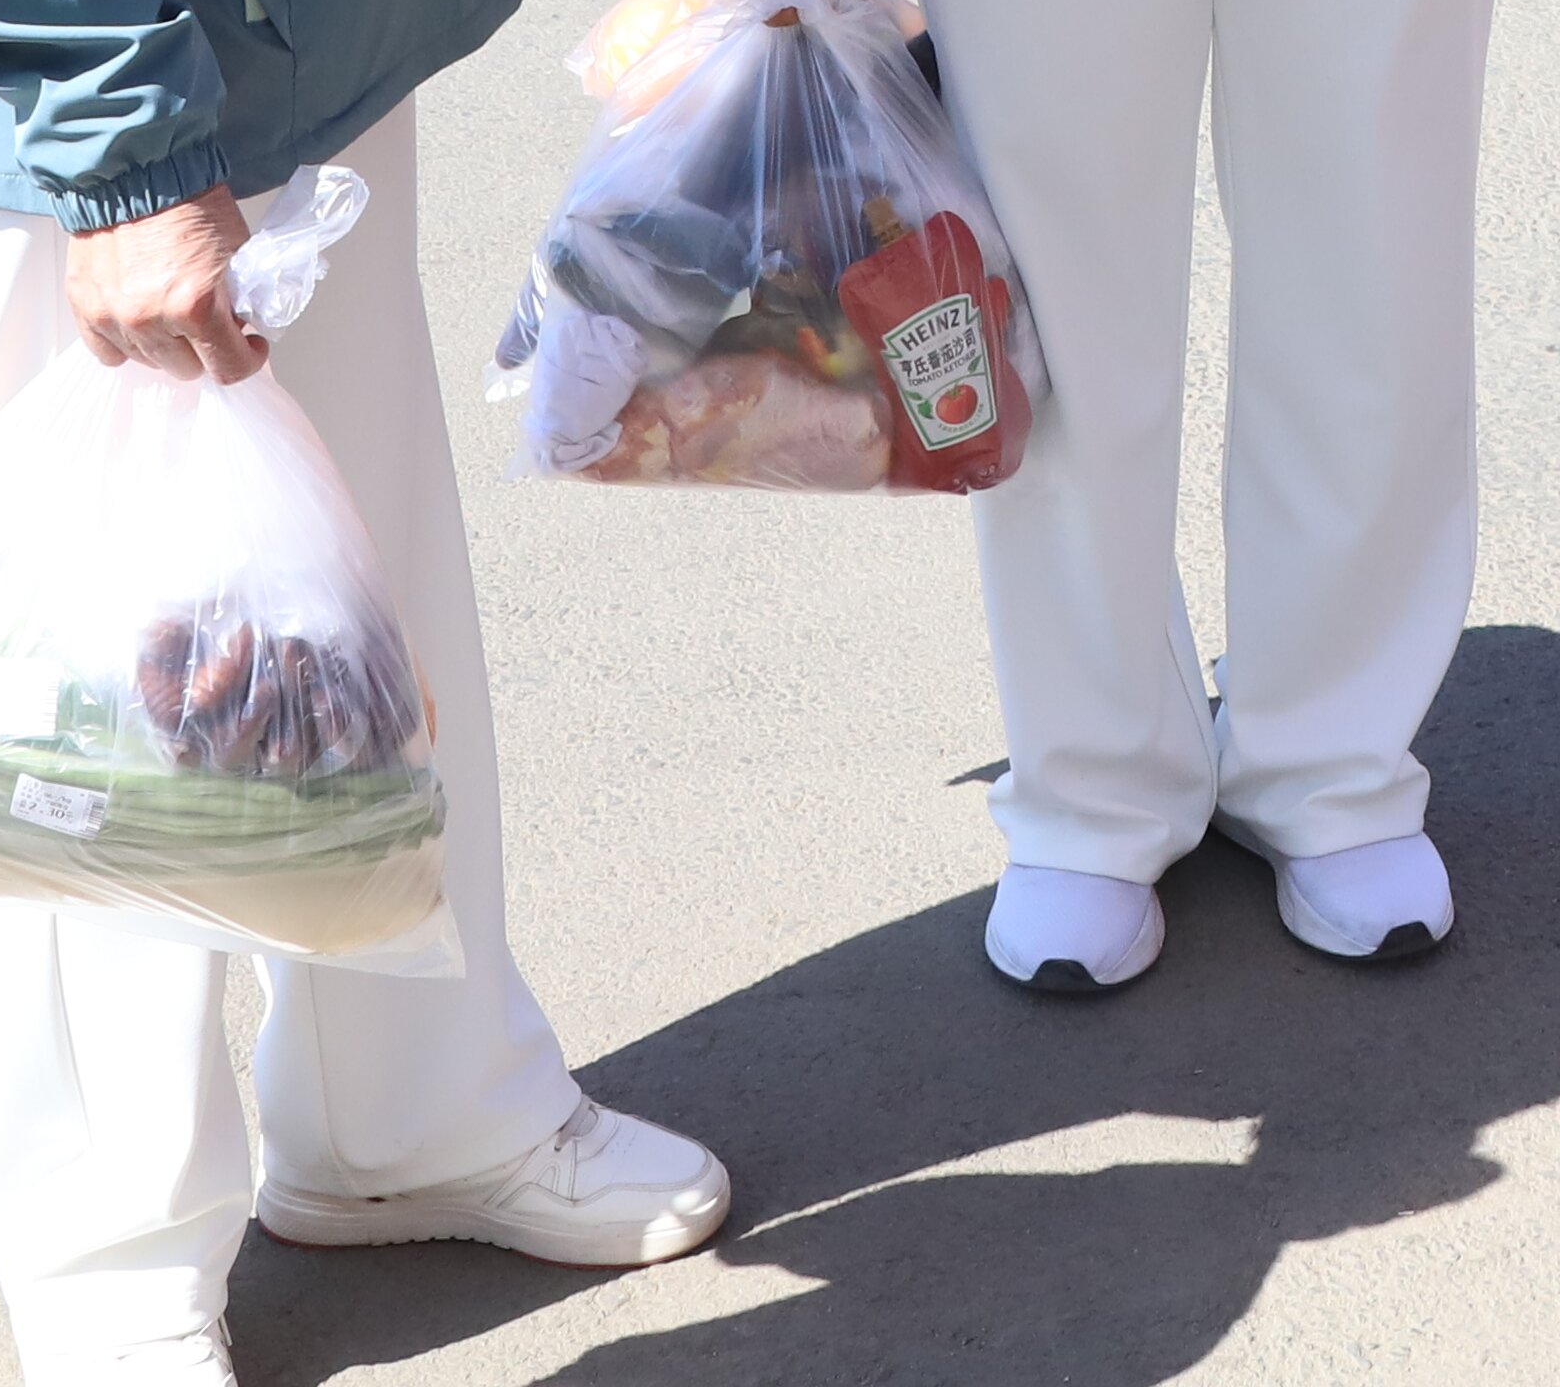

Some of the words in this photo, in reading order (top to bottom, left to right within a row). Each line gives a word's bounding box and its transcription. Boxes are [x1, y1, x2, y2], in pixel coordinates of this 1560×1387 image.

[899, 308, 961, 352] HEINZ
[899, 328, 977, 378] 亨氏番茄沙司
[908, 370, 943, 387] TOMATO
[943, 348, 978, 375] KETCHUP
